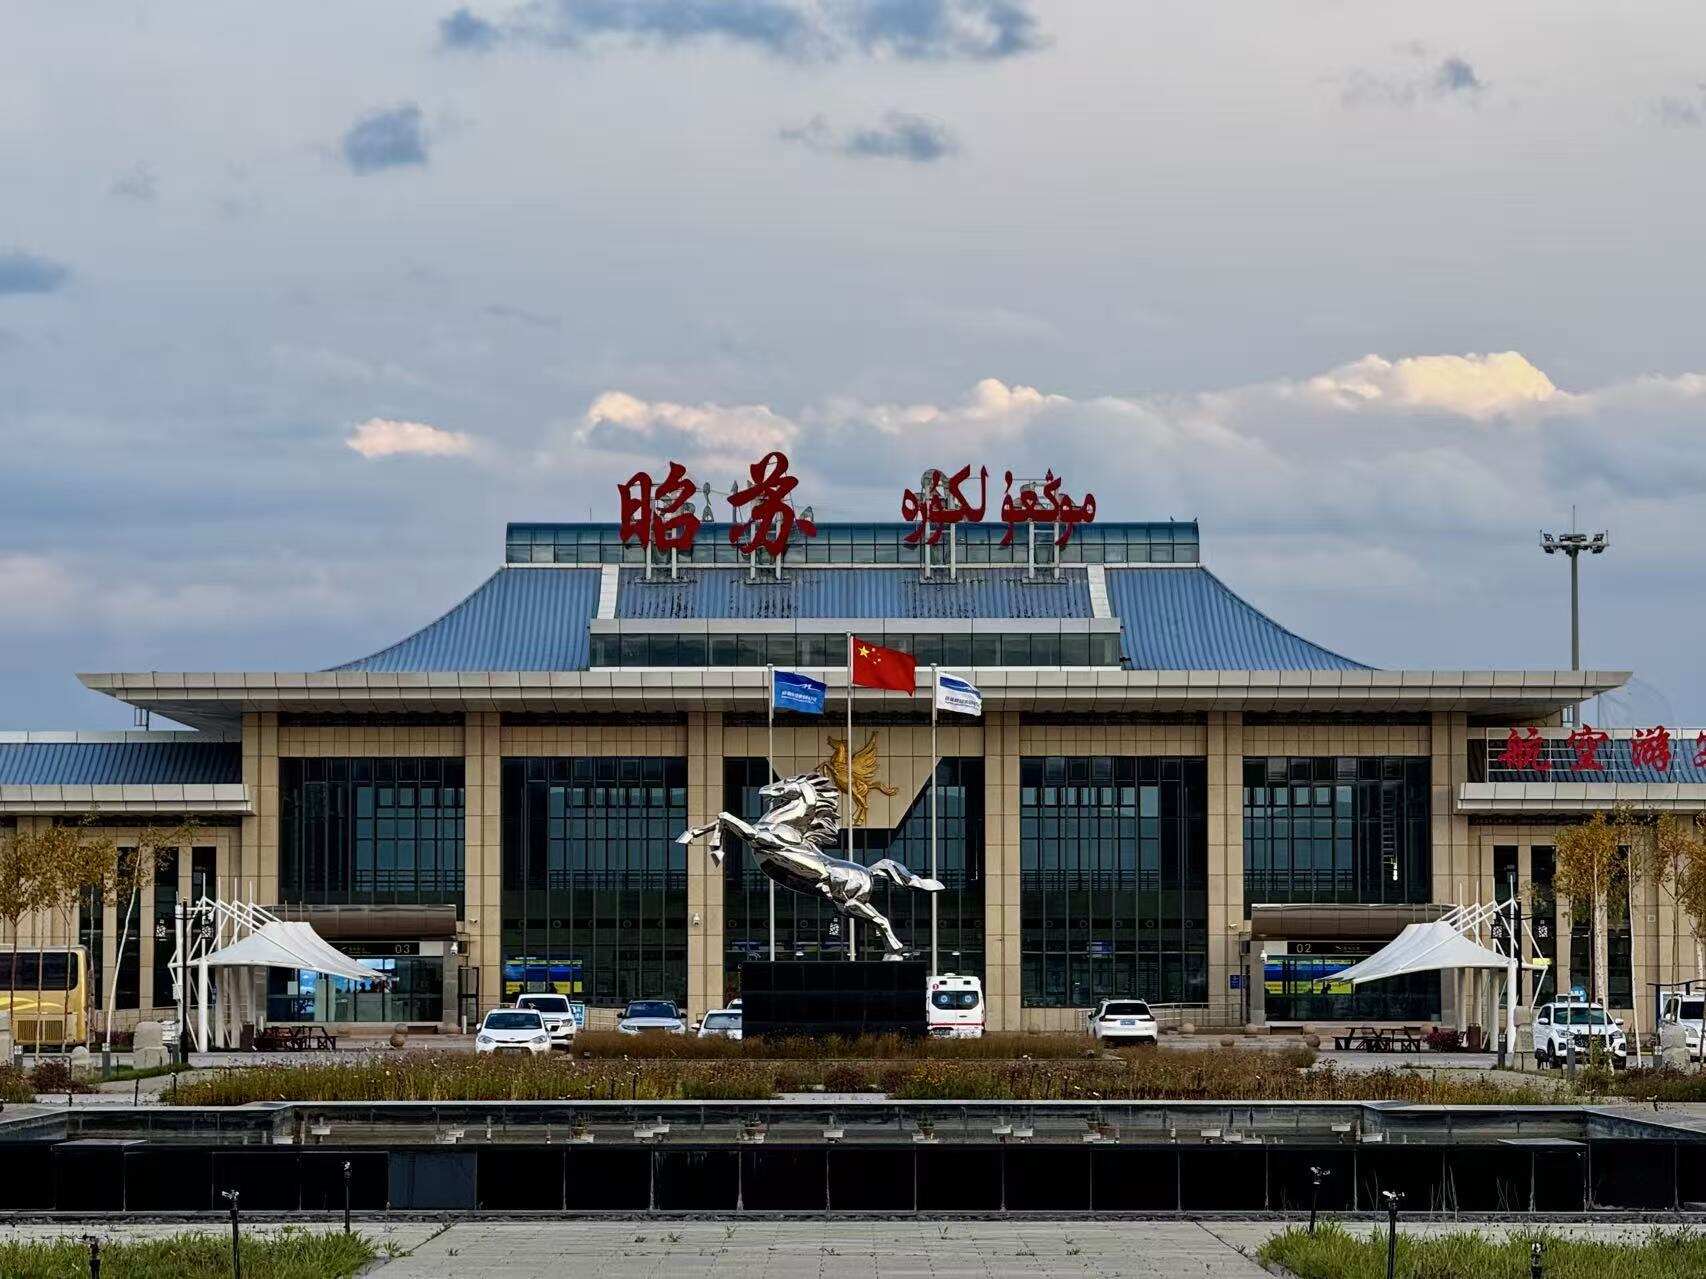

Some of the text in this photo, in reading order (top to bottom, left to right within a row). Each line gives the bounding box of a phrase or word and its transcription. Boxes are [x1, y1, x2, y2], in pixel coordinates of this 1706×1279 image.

[617, 451, 816, 556] 昭苏
[1498, 723, 1706, 772] 航空游
[395, 944, 410, 954] 03
[1296, 943, 1312, 953] 02
